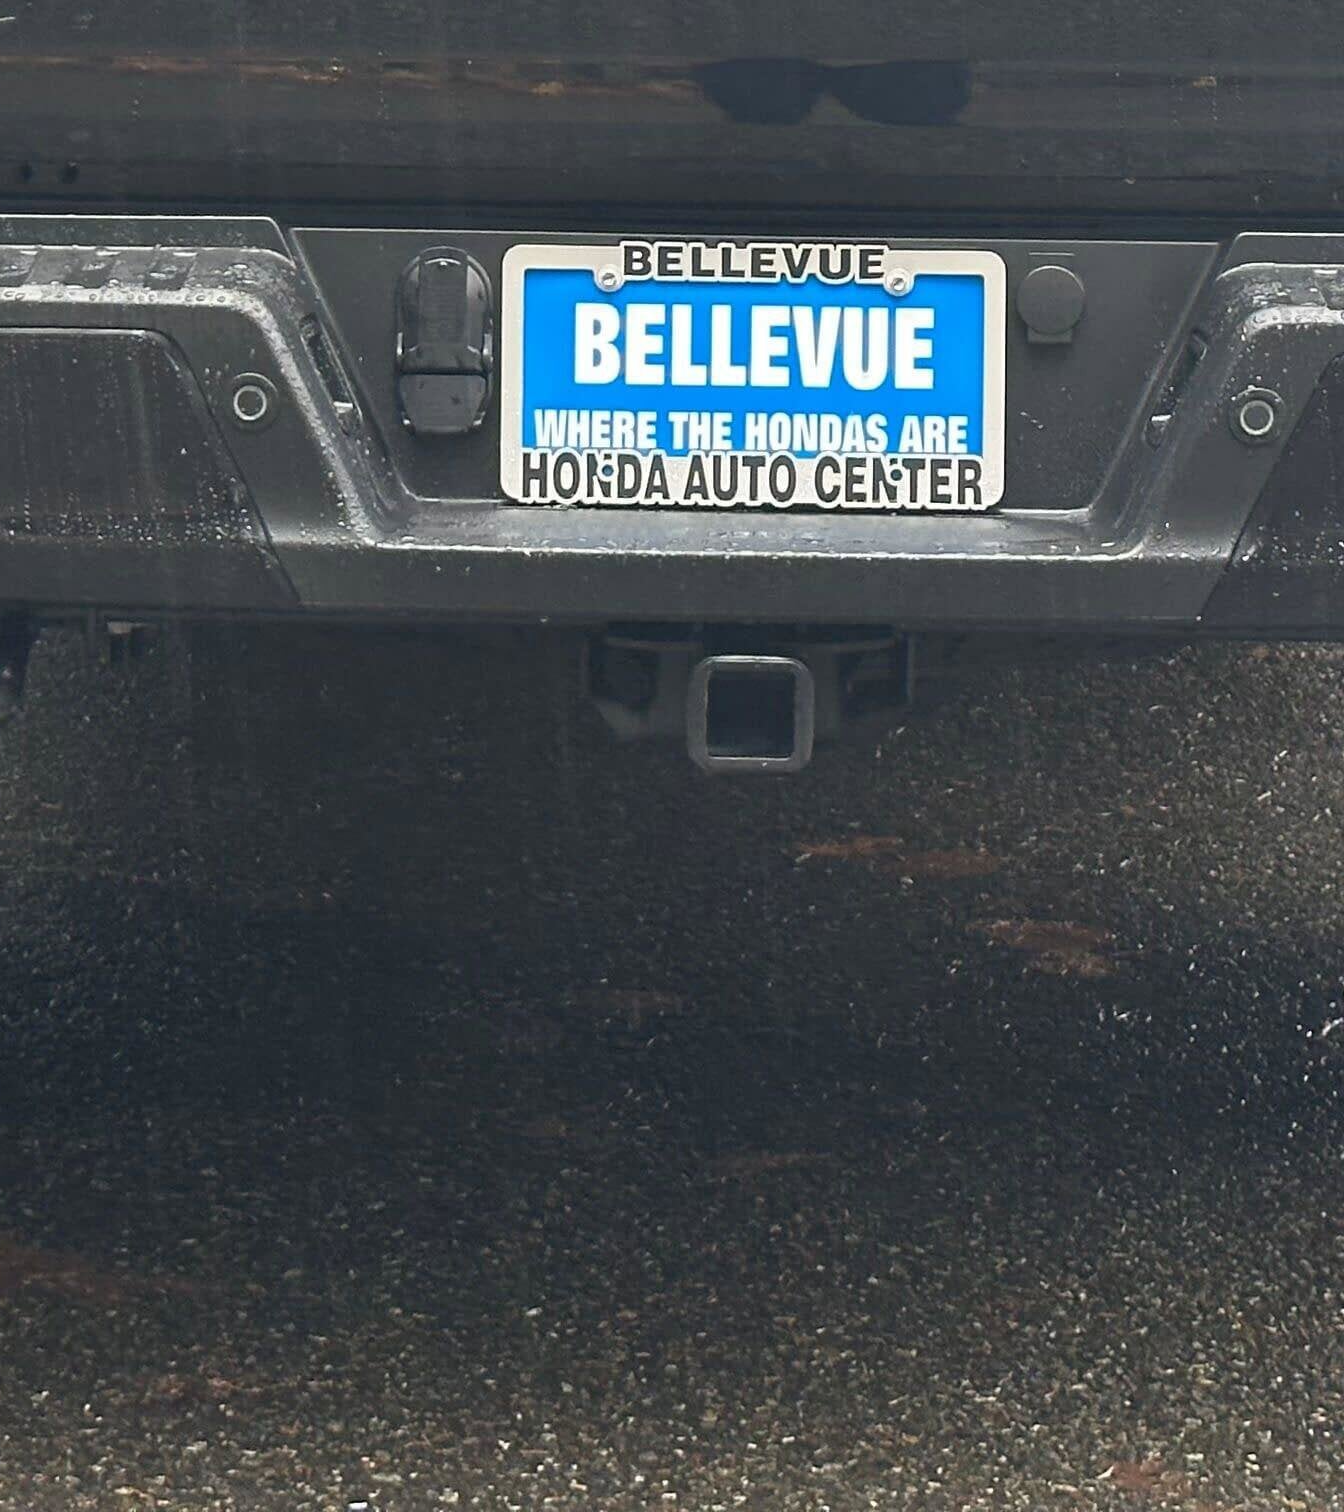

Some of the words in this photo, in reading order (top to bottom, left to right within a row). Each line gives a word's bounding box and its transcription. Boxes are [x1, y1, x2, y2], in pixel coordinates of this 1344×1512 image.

[622, 244, 887, 281] BELLEVUE
[574, 301, 935, 391] BELLEVUE
[534, 408, 657, 449] WHERE
[668, 410, 734, 451] THE
[744, 411, 889, 453] HONDAS
[898, 414, 969, 454] ARE
[521, 451, 671, 501] HONDA
[683, 454, 804, 503] AUTO
[814, 455, 984, 505] CENTER
